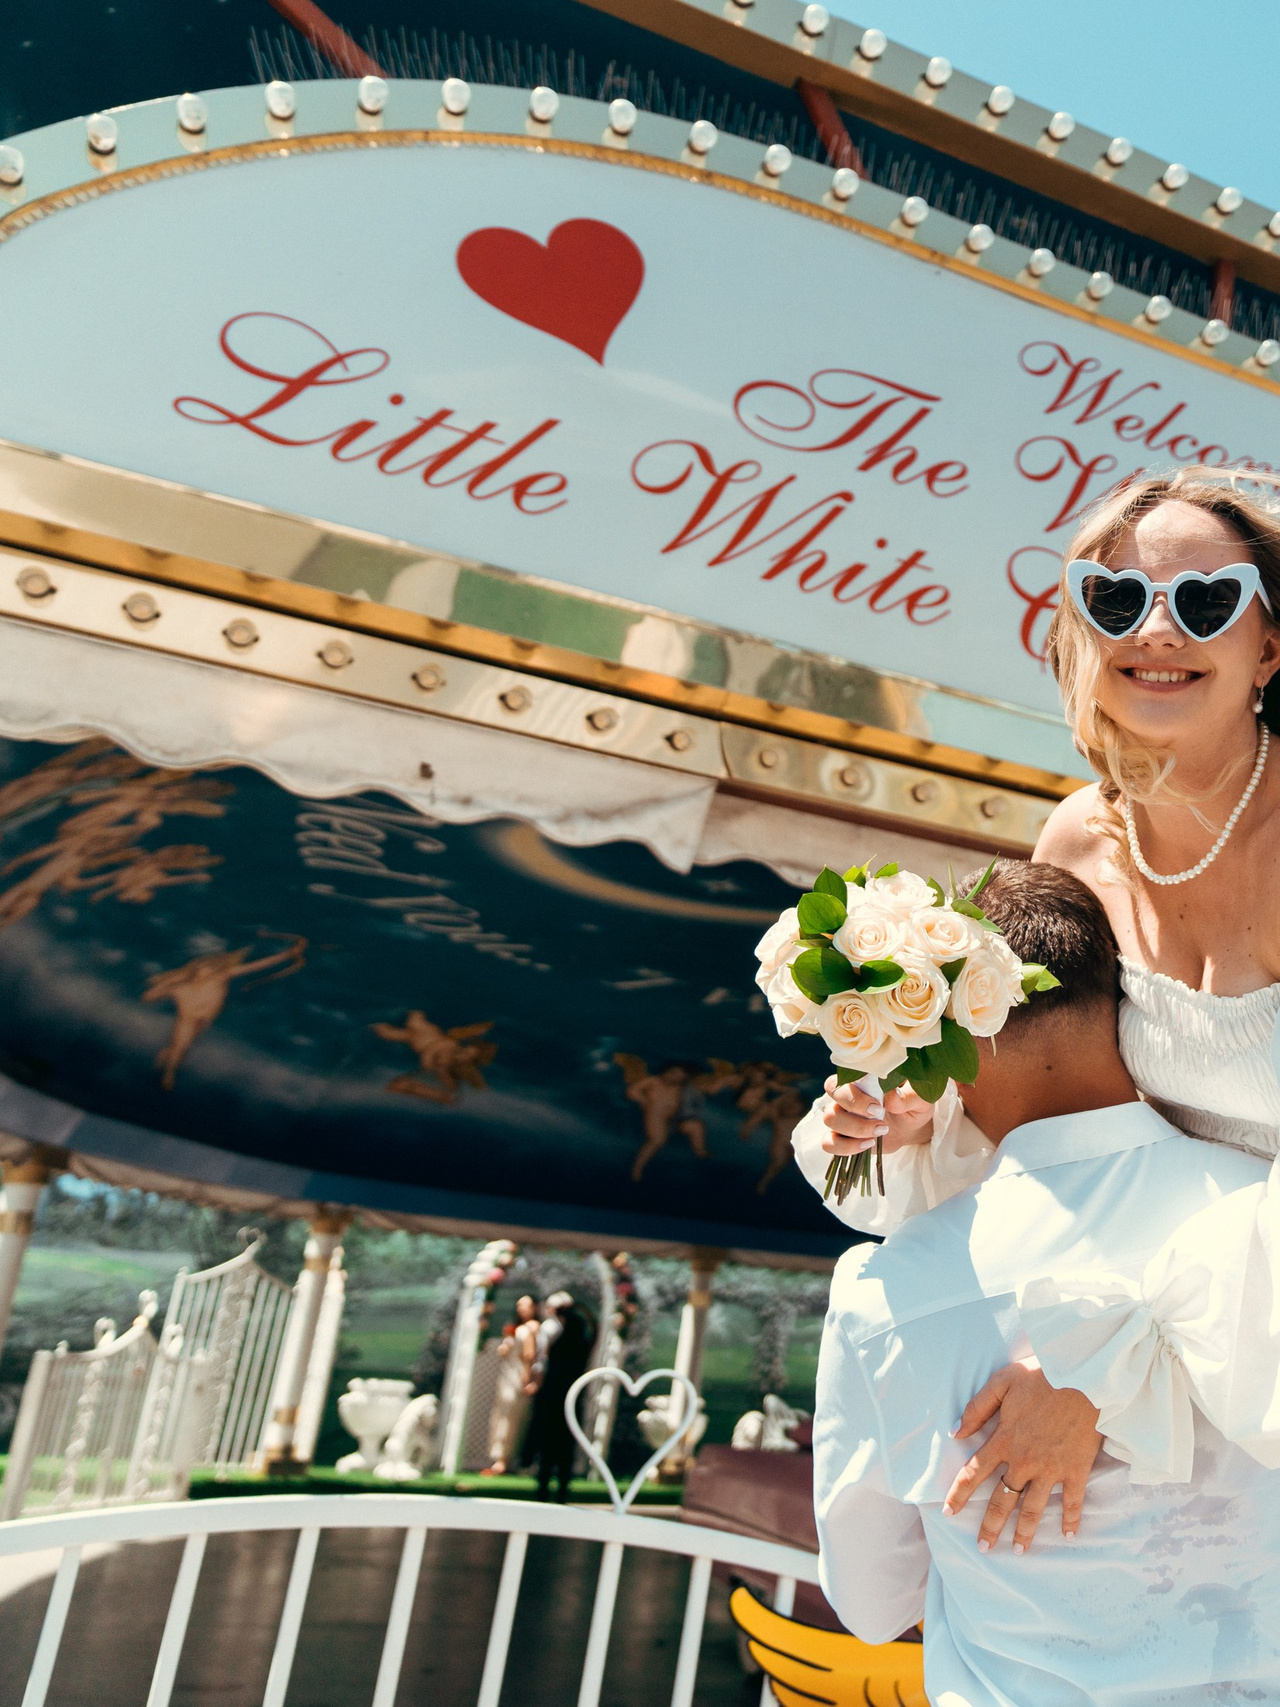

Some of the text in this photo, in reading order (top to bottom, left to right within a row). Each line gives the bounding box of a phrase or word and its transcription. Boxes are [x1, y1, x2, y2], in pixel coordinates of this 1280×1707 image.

[173, 311, 570, 516] Little
[631, 439, 951, 626] White
[733, 367, 969, 498] The
